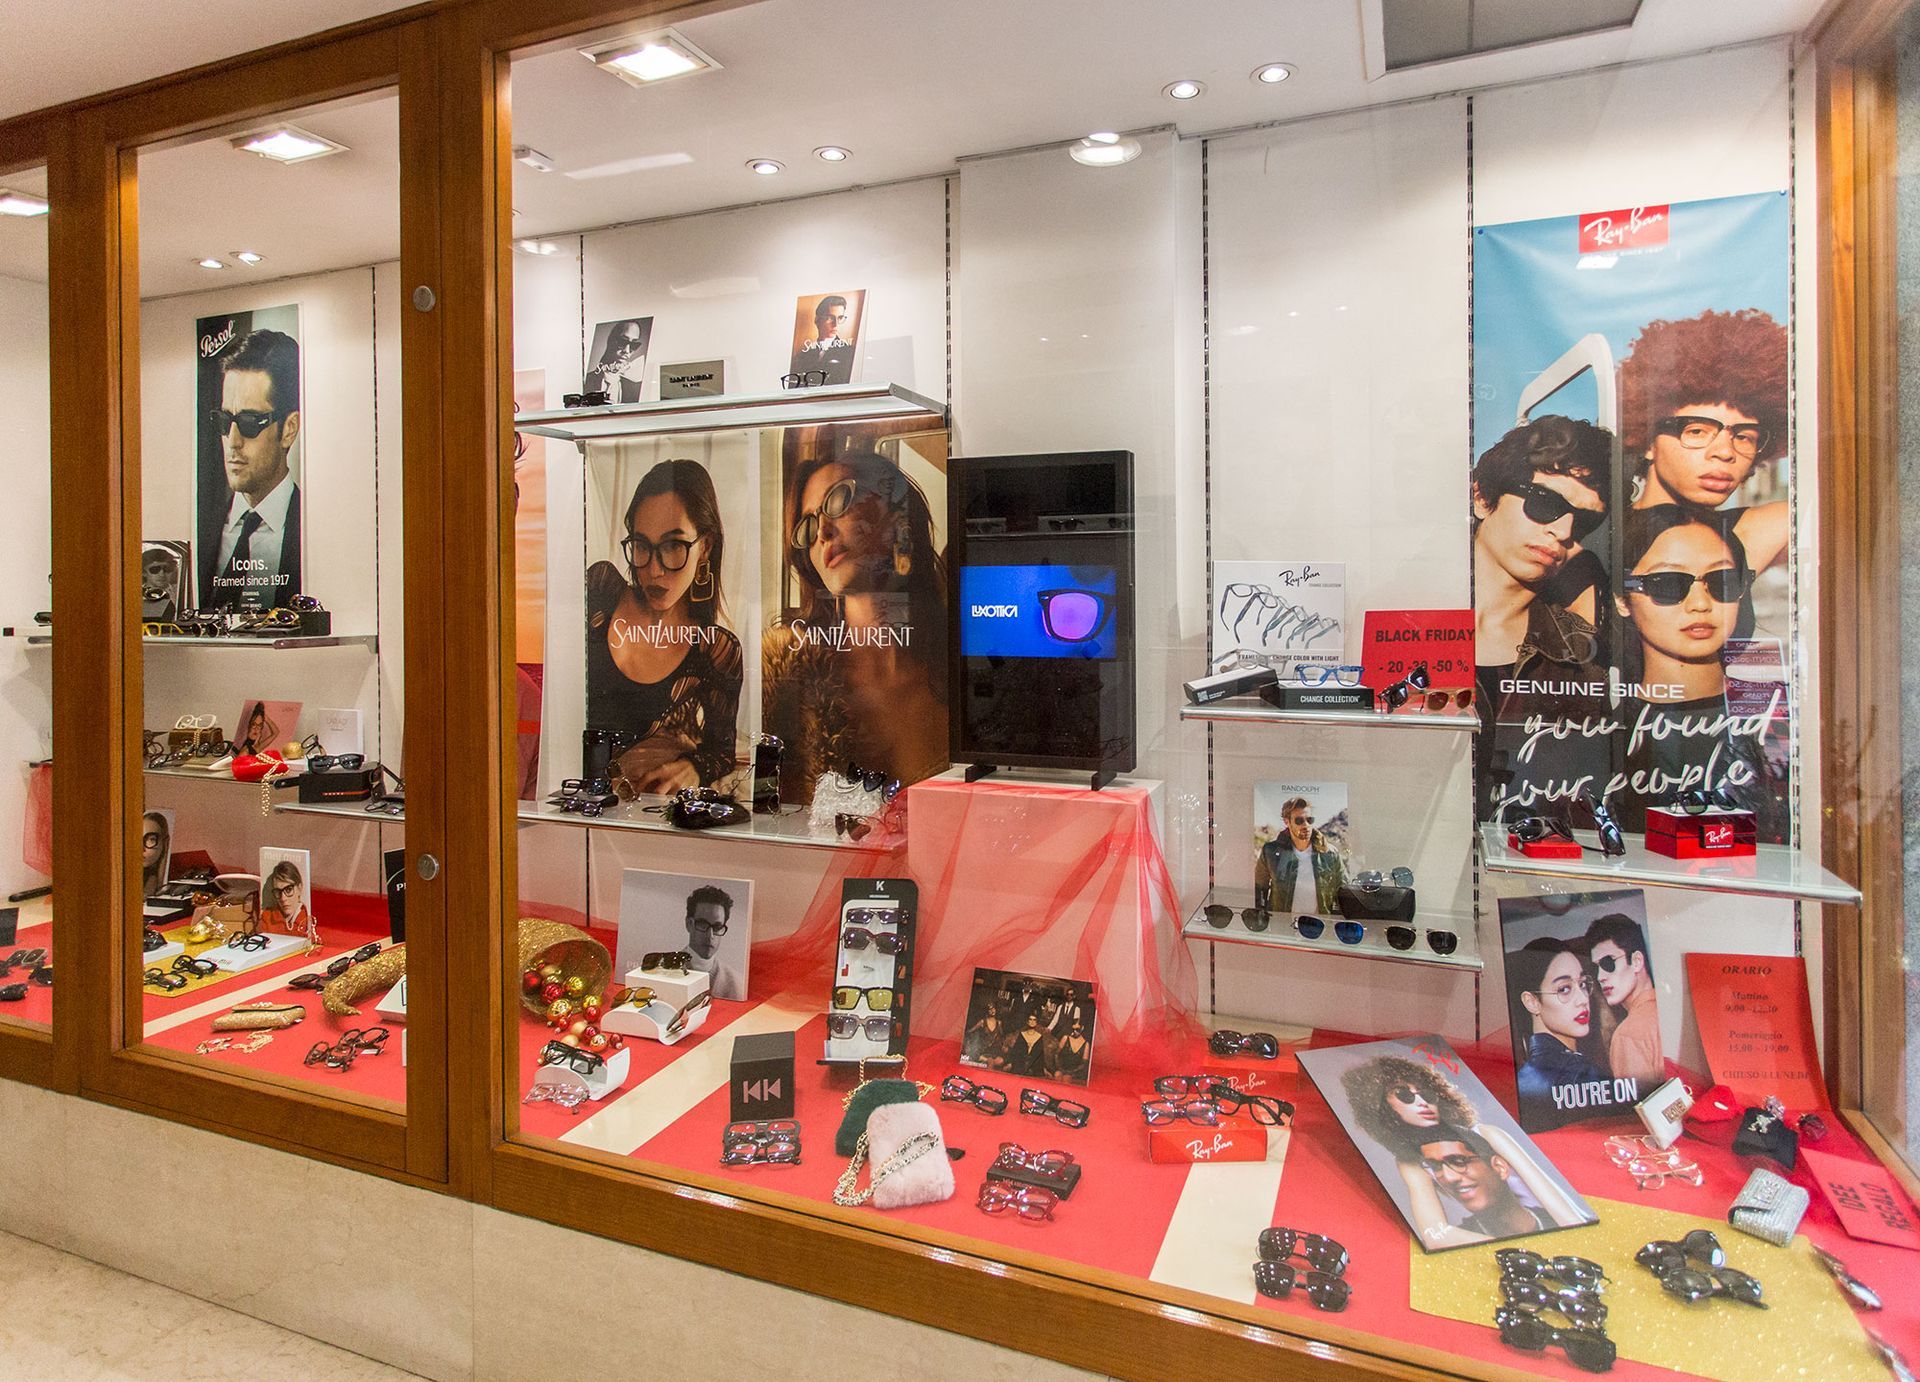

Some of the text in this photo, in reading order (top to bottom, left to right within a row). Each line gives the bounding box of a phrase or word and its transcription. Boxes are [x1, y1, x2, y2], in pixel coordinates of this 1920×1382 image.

[200, 319, 236, 358] Persol
[232, 556, 268, 571] Icons.
[213, 574, 290, 587] Framed since 1917
[1375, 629, 1475, 642] BLACK FRIDAY
[1500, 679, 1686, 699] GENUINE SINCE
[1300, 695, 1323, 704] CHANGE
[1517, 688, 1782, 764] you found
[1281, 784, 1320, 794] RANDOLPH
[1489, 740, 1755, 824] your people
[1722, 965, 1772, 975] ORARIO
[1551, 1077, 1638, 1109] YOU'RE ON
